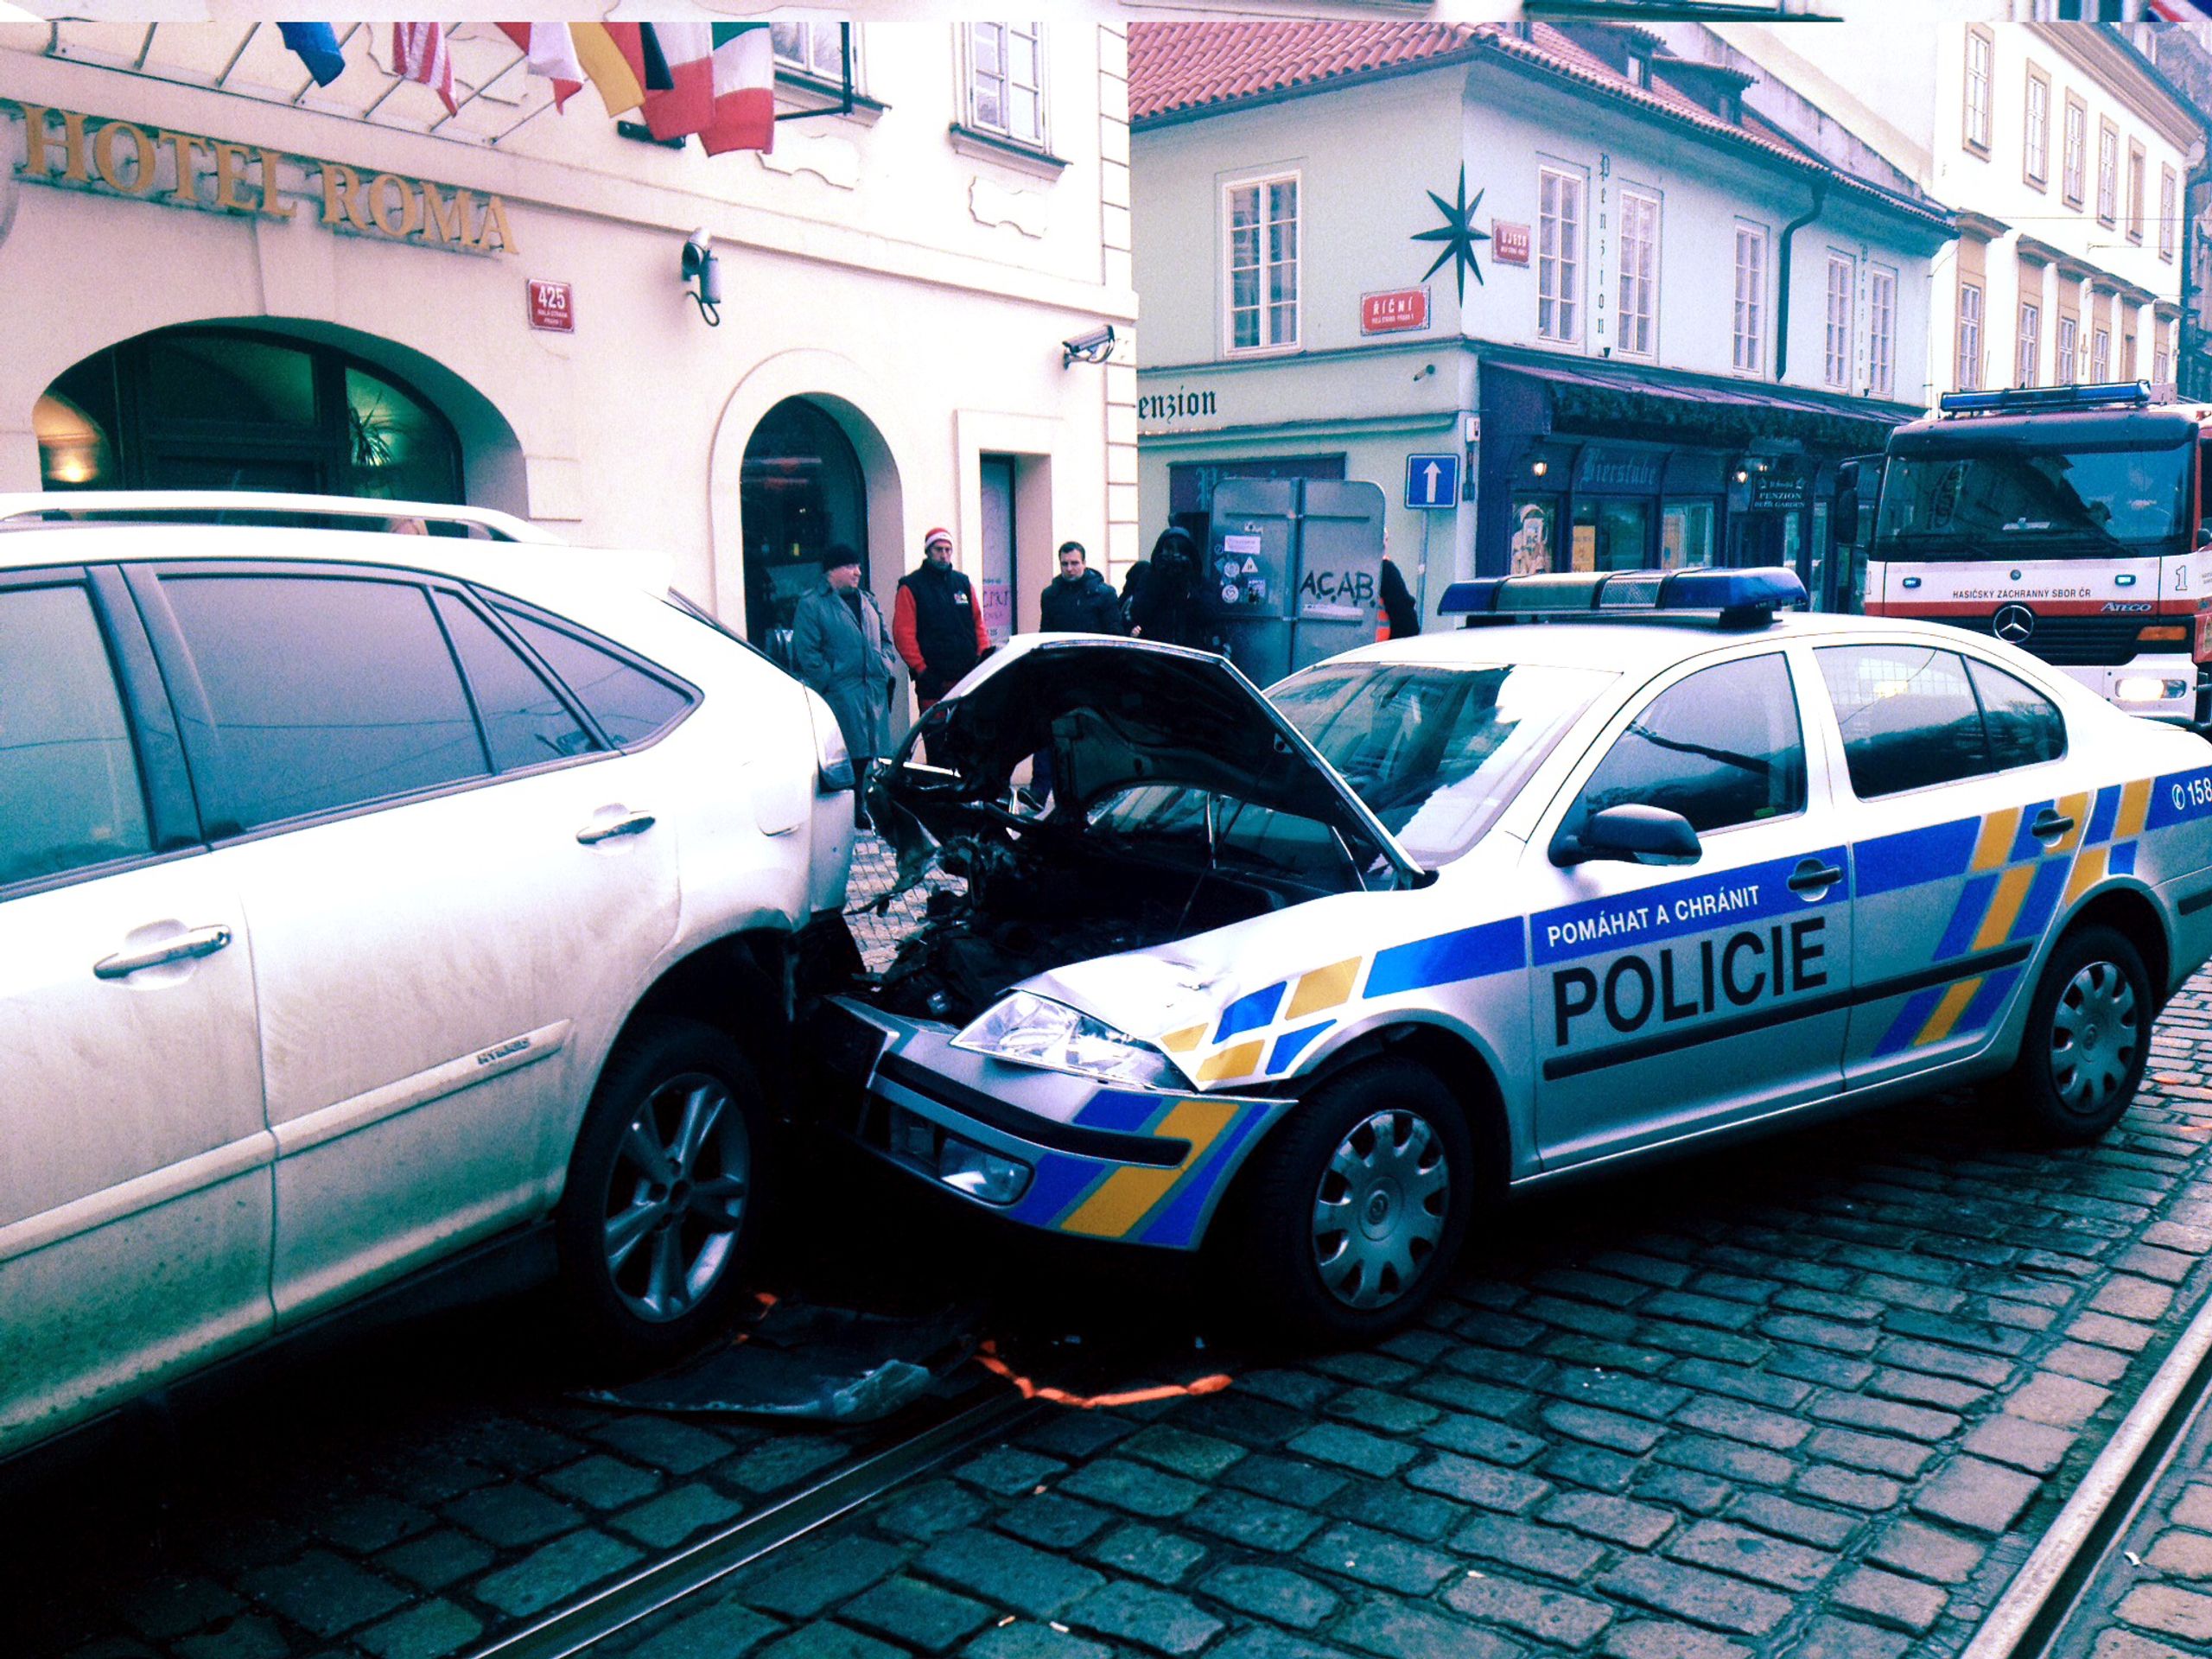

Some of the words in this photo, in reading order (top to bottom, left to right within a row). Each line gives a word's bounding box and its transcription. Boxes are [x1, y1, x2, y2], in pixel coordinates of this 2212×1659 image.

[19, 101, 298, 219] HOTEL
[317, 162, 519, 255] ROMA
[1597, 153, 1610, 334] Penzion
[537, 284, 566, 309] 425
[1373, 296, 1414, 315] ŘÍČNÍ
[1138, 385, 1217, 424] enzion
[2051, 588, 2076, 598] SBOR
[2175, 564, 2189, 592] 1
[2187, 777, 2212, 806] 158
[1548, 910, 1649, 947] POMÁHAT
[1656, 905, 1670, 925] A
[1675, 886, 1760, 920] CHRÁNIT
[1553, 916, 1827, 1046] POLICIE
